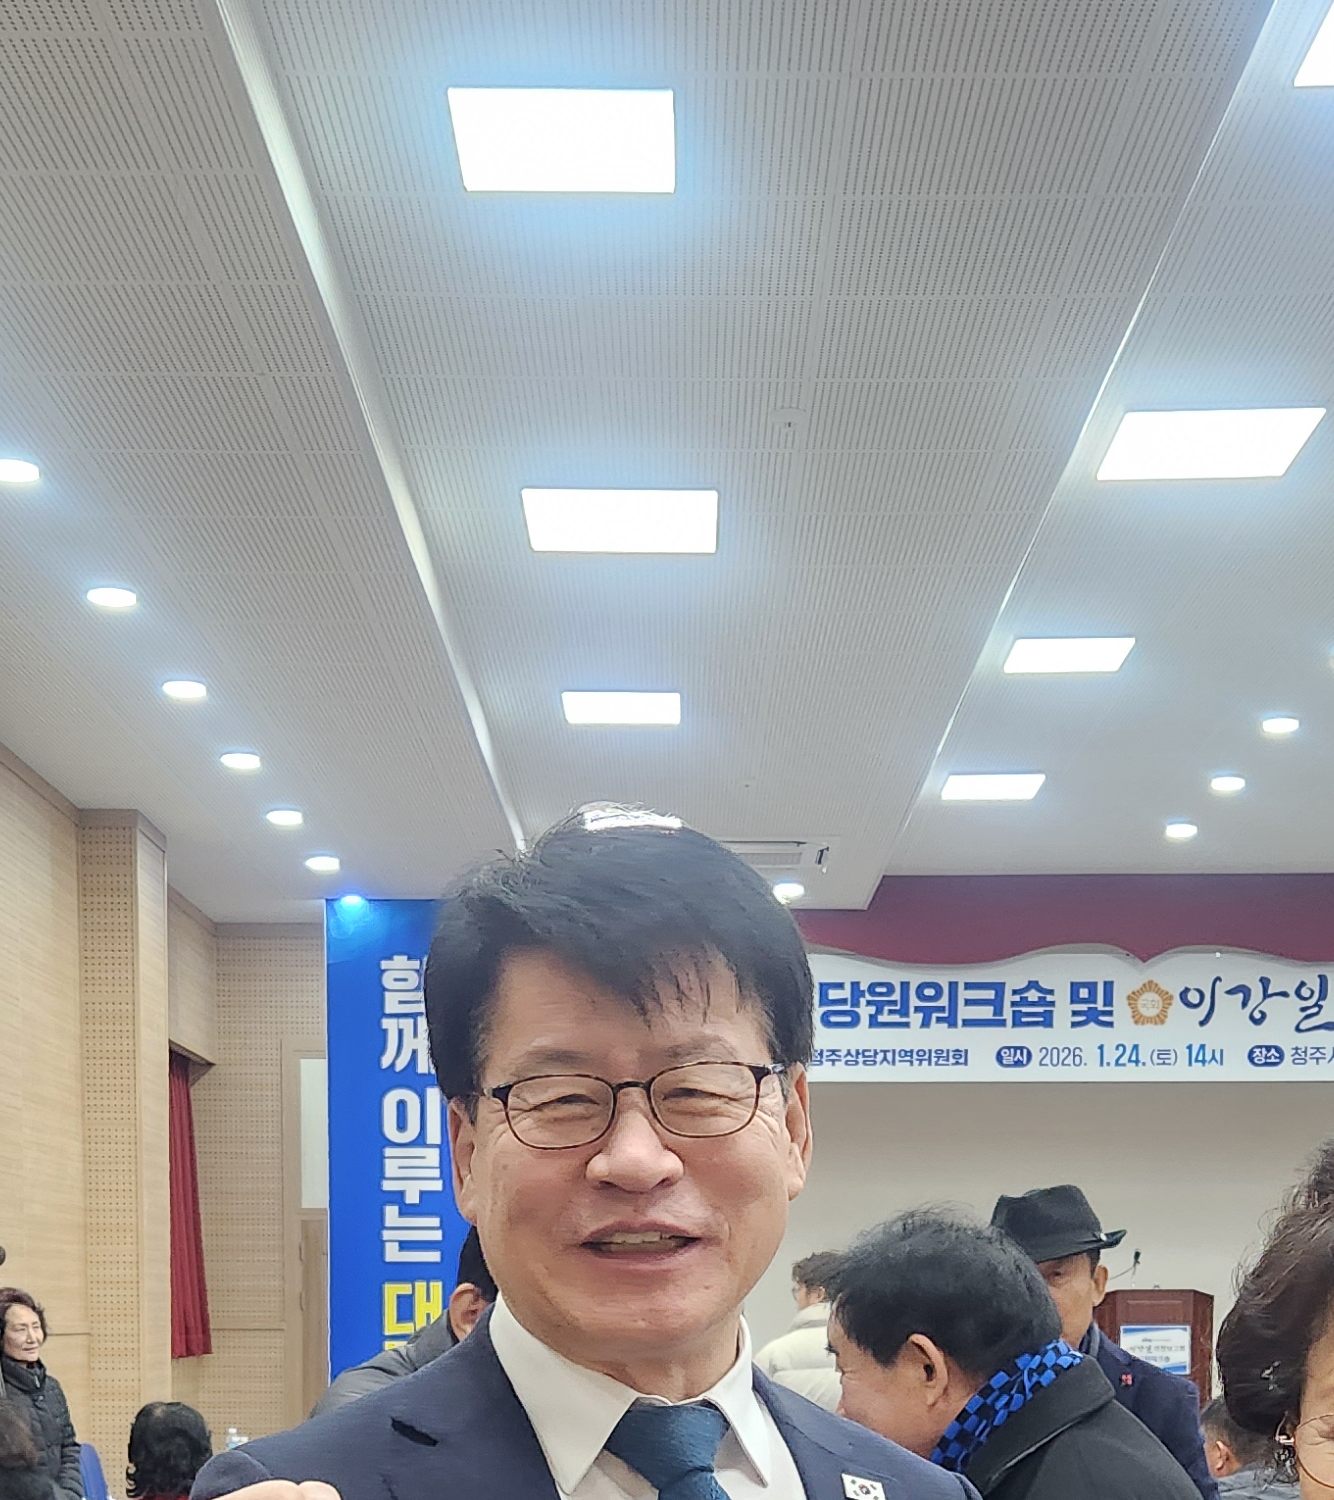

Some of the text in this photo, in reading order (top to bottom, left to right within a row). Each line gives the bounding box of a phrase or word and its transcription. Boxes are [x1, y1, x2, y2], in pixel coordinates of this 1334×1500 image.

[818, 979, 1056, 1029] 당원워크숍
[1069, 979, 1115, 1029] 및
[1000, 1048, 1029, 1065] 일시
[1038, 1046, 1087, 1067] 2026.
[1185, 1043, 1225, 1067] 14시
[1251, 1048, 1282, 1064] 장소
[381, 1086, 443, 1263] 이루는
